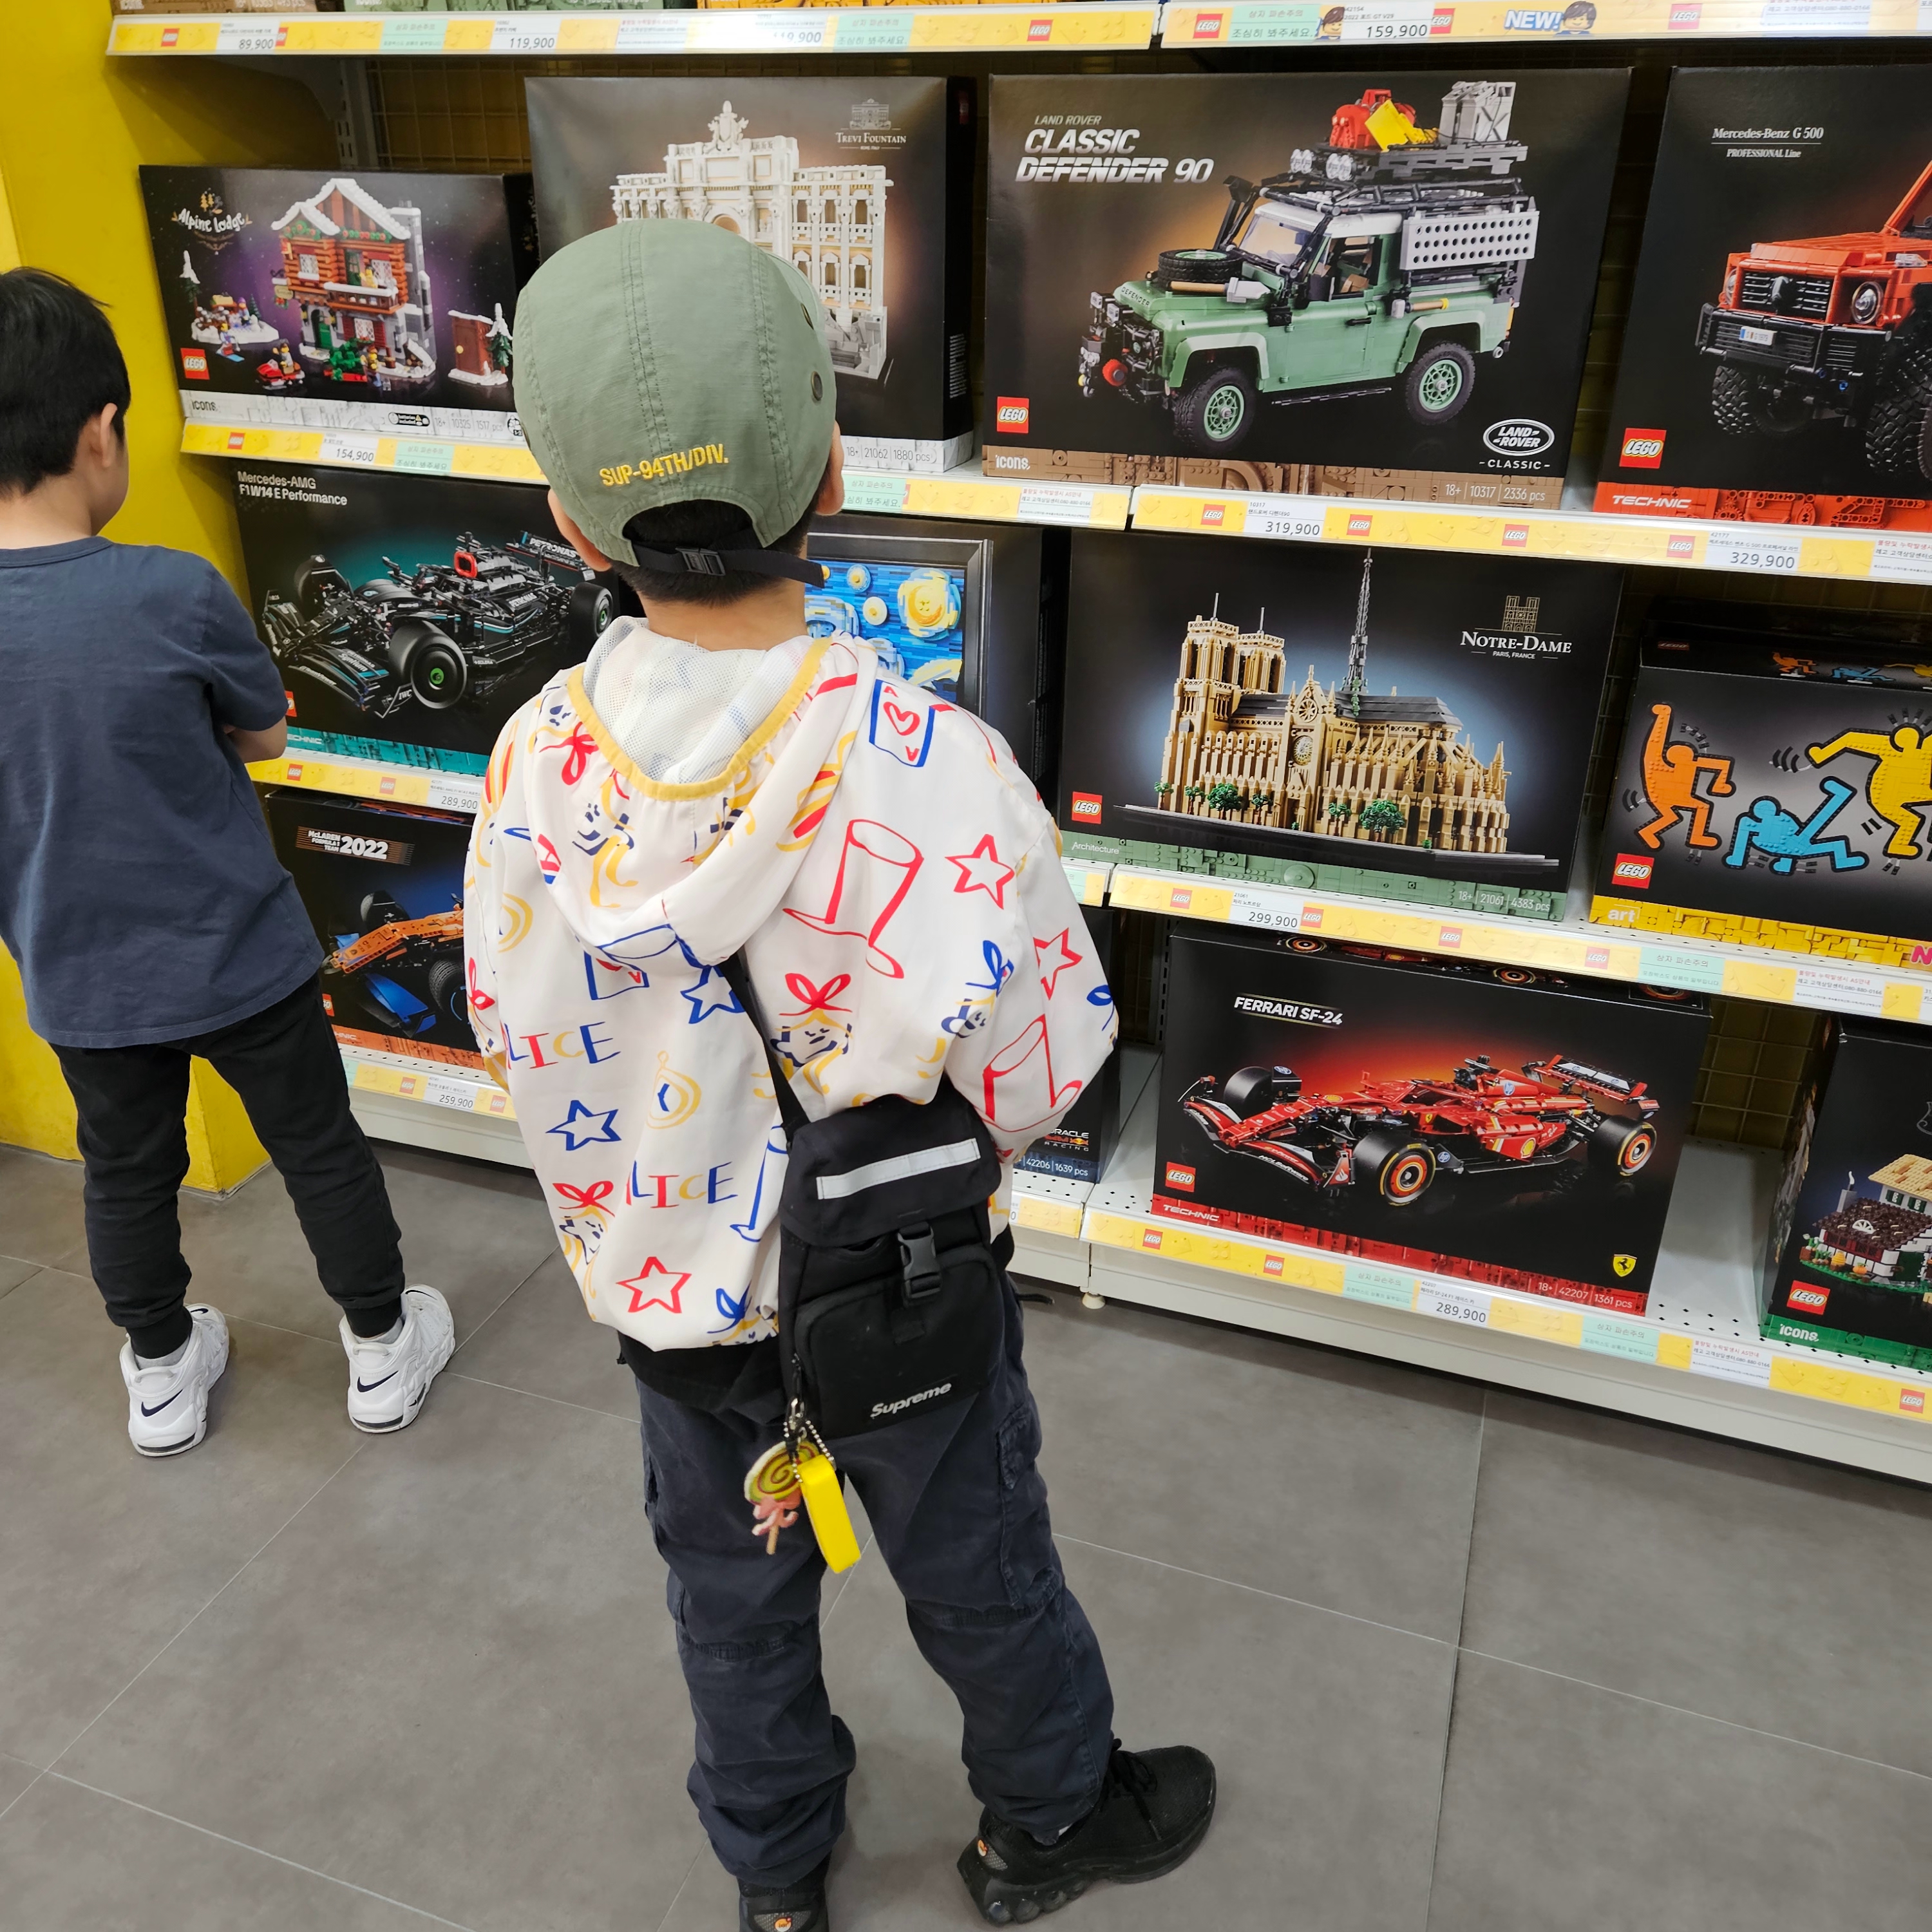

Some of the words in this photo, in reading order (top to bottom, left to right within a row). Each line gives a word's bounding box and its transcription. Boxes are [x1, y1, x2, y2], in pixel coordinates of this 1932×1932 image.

[1249, 10, 1265, 18] 상자
[1269, 9, 1304, 18] 파손주의
[1504, 10, 1564, 31] NEW!
[1670, 11, 1699, 22] LEGO
[1196, 21, 1220, 32] LEGO
[1432, 17, 1451, 26] EGO
[1029, 24, 1051, 36] LEGO
[1231, 28, 1263, 38] 조심히
[1367, 24, 1428, 38] 159,900
[239, 39, 274, 51] 89,900
[509, 37, 554, 49] 119,900
[1034, 115, 1063, 126] LAND
[1065, 115, 1102, 126] ROVER
[1712, 128, 1790, 139] Mercedes-Benz
[1792, 128, 1802, 139] G
[1803, 127, 1824, 139] 500
[1024, 128, 1140, 154] CLASSIC
[1727, 149, 1784, 158] PROFESSIONAL
[1785, 149, 1801, 158] Line
[1015, 156, 1169, 183] DEFENDER
[1173, 158, 1215, 184] 90
[178, 208, 212, 232] Alpine
[1121, 287, 1150, 307] DEFENDER
[185, 357, 205, 370] LEGO
[192, 398, 216, 412] icons
[999, 408, 1027, 422] LEGO
[435, 417, 446, 427] 18+
[451, 419, 471, 429] 10325
[476, 420, 490, 430] 1517
[1498, 427, 1532, 437] LAND
[1499, 437, 1541, 448] ROVER
[1625, 440, 1661, 456] LEGO
[336, 448, 374, 462] 154,900
[846, 446, 859, 457] 18+
[865, 447, 888, 459] 21062
[894, 449, 913, 460] 1880
[916, 451, 930, 463] pcs
[600, 443, 729, 487] SUP-94TH/DIV.
[995, 455, 1029, 470] icons
[1487, 459, 1542, 470] CLASSIC
[238, 471, 316, 489] Mercedes-AMG
[281, 489, 348, 506] Performance
[1445, 484, 1462, 496] 18+
[1470, 486, 1497, 498] 10317
[1503, 488, 1527, 500] 2336
[1530, 491, 1546, 502] pcs
[844, 495, 862, 504] 심히
[866, 497, 900, 507] 봐주세요.
[1613, 495, 1692, 509] TECHNIC
[1203, 510, 1224, 520] LEGO
[1265, 521, 1320, 536] 319,900
[1349, 520, 1370, 530] LEGO
[1504, 531, 1526, 540] LEGO
[1669, 542, 1692, 551] LEGO
[1730, 552, 1795, 569] 329,900
[399, 689, 412, 700] IWC
[287, 734, 322, 744] ECHNIC
[441, 795, 478, 809] 289,900
[1074, 800, 1099, 814] LEGO
[340, 835, 388, 860] 2022
[1072, 842, 1119, 855] Architecture
[1616, 863, 1650, 878] LEGO
[1173, 894, 1190, 902] LEGO
[1459, 891, 1473, 900] 18+
[1480, 893, 1504, 905] 21061
[1511, 897, 1534, 909] 4383
[1535, 902, 1549, 912] pcs
[1249, 911, 1298, 927] 299,900
[1303, 913, 1322, 922] LEGO
[1607, 909, 1636, 923] art
[1441, 933, 1460, 942] LEGO
[1588, 954, 1607, 962] LEGO
[1656, 954, 1673, 963] 상자
[1676, 958, 1709, 967] 파손주의
[1234, 996, 1298, 1018] FERRARI
[1299, 1003, 1343, 1026] SF-24
[500, 1021, 621, 1070] LICE
[439, 1095, 473, 1108] 259,900
[1044, 1141, 1089, 1151] RACING
[1026, 1158, 1050, 1170] 42206
[1055, 1163, 1073, 1173] 1639
[625, 1160, 738, 1209] LICE
[1168, 1171, 1193, 1184] LEGO
[1163, 1204, 1219, 1222] TECHNIC
[1144, 1235, 1160, 1244] LEGO
[1265, 1260, 1283, 1270] LEGO
[1374, 1275, 1401, 1286] 파손주의
[1538, 1282, 1553, 1292] 18+
[1558, 1286, 1589, 1300] 42207
[1594, 1294, 1614, 1305] 1361
[1615, 1298, 1633, 1309] pcs
[1792, 1290, 1825, 1305] LEGO
[1436, 1302, 1486, 1323] 289,900
[1596, 1323, 1613, 1332] 상자
[1615, 1327, 1645, 1339] 파손주의
[1779, 1323, 1818, 1341] icons
[870, 1383, 952, 1419] Supreme
[1901, 1396, 1922, 1406] LEGO
